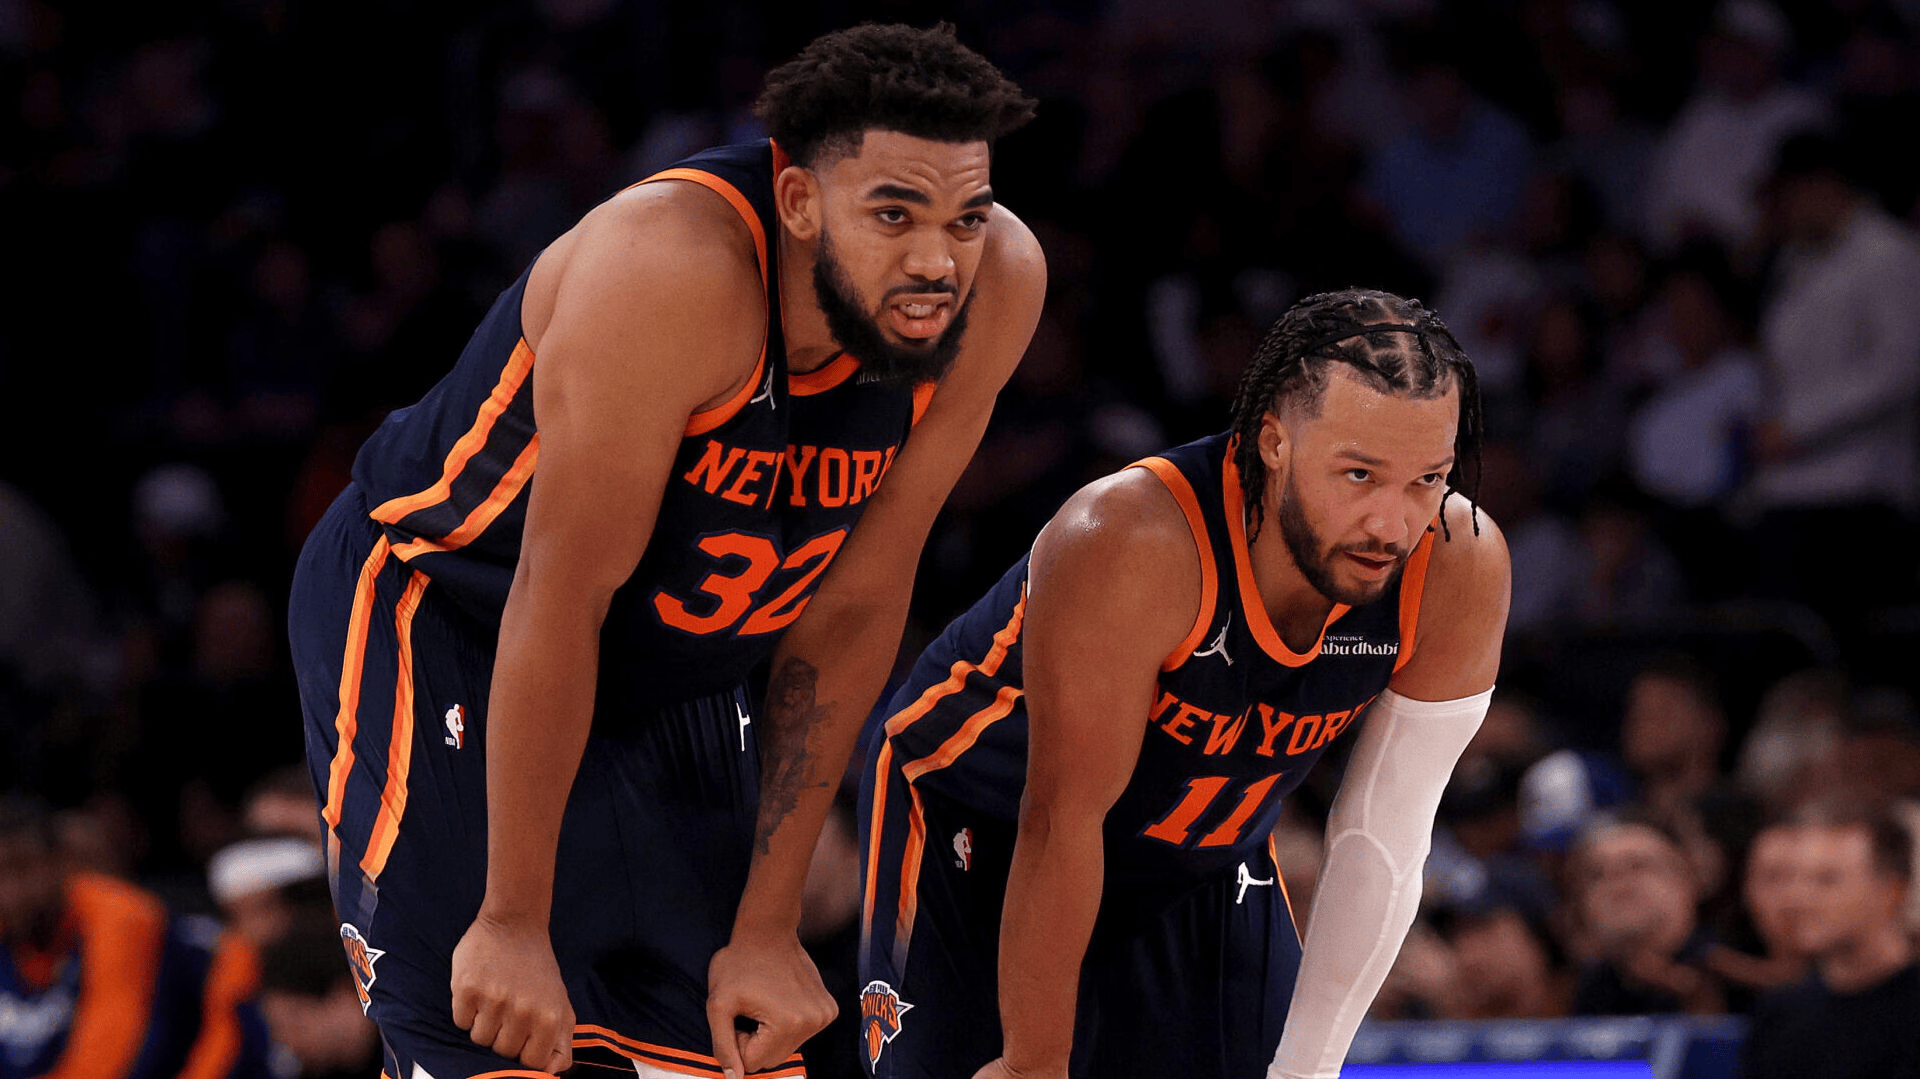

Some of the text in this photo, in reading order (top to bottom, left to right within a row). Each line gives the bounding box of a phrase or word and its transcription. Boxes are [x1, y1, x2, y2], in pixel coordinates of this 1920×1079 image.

[652, 523, 849, 637] 32
[1352, 642, 1399, 655] dhabi
[1143, 772, 1283, 848] 11
